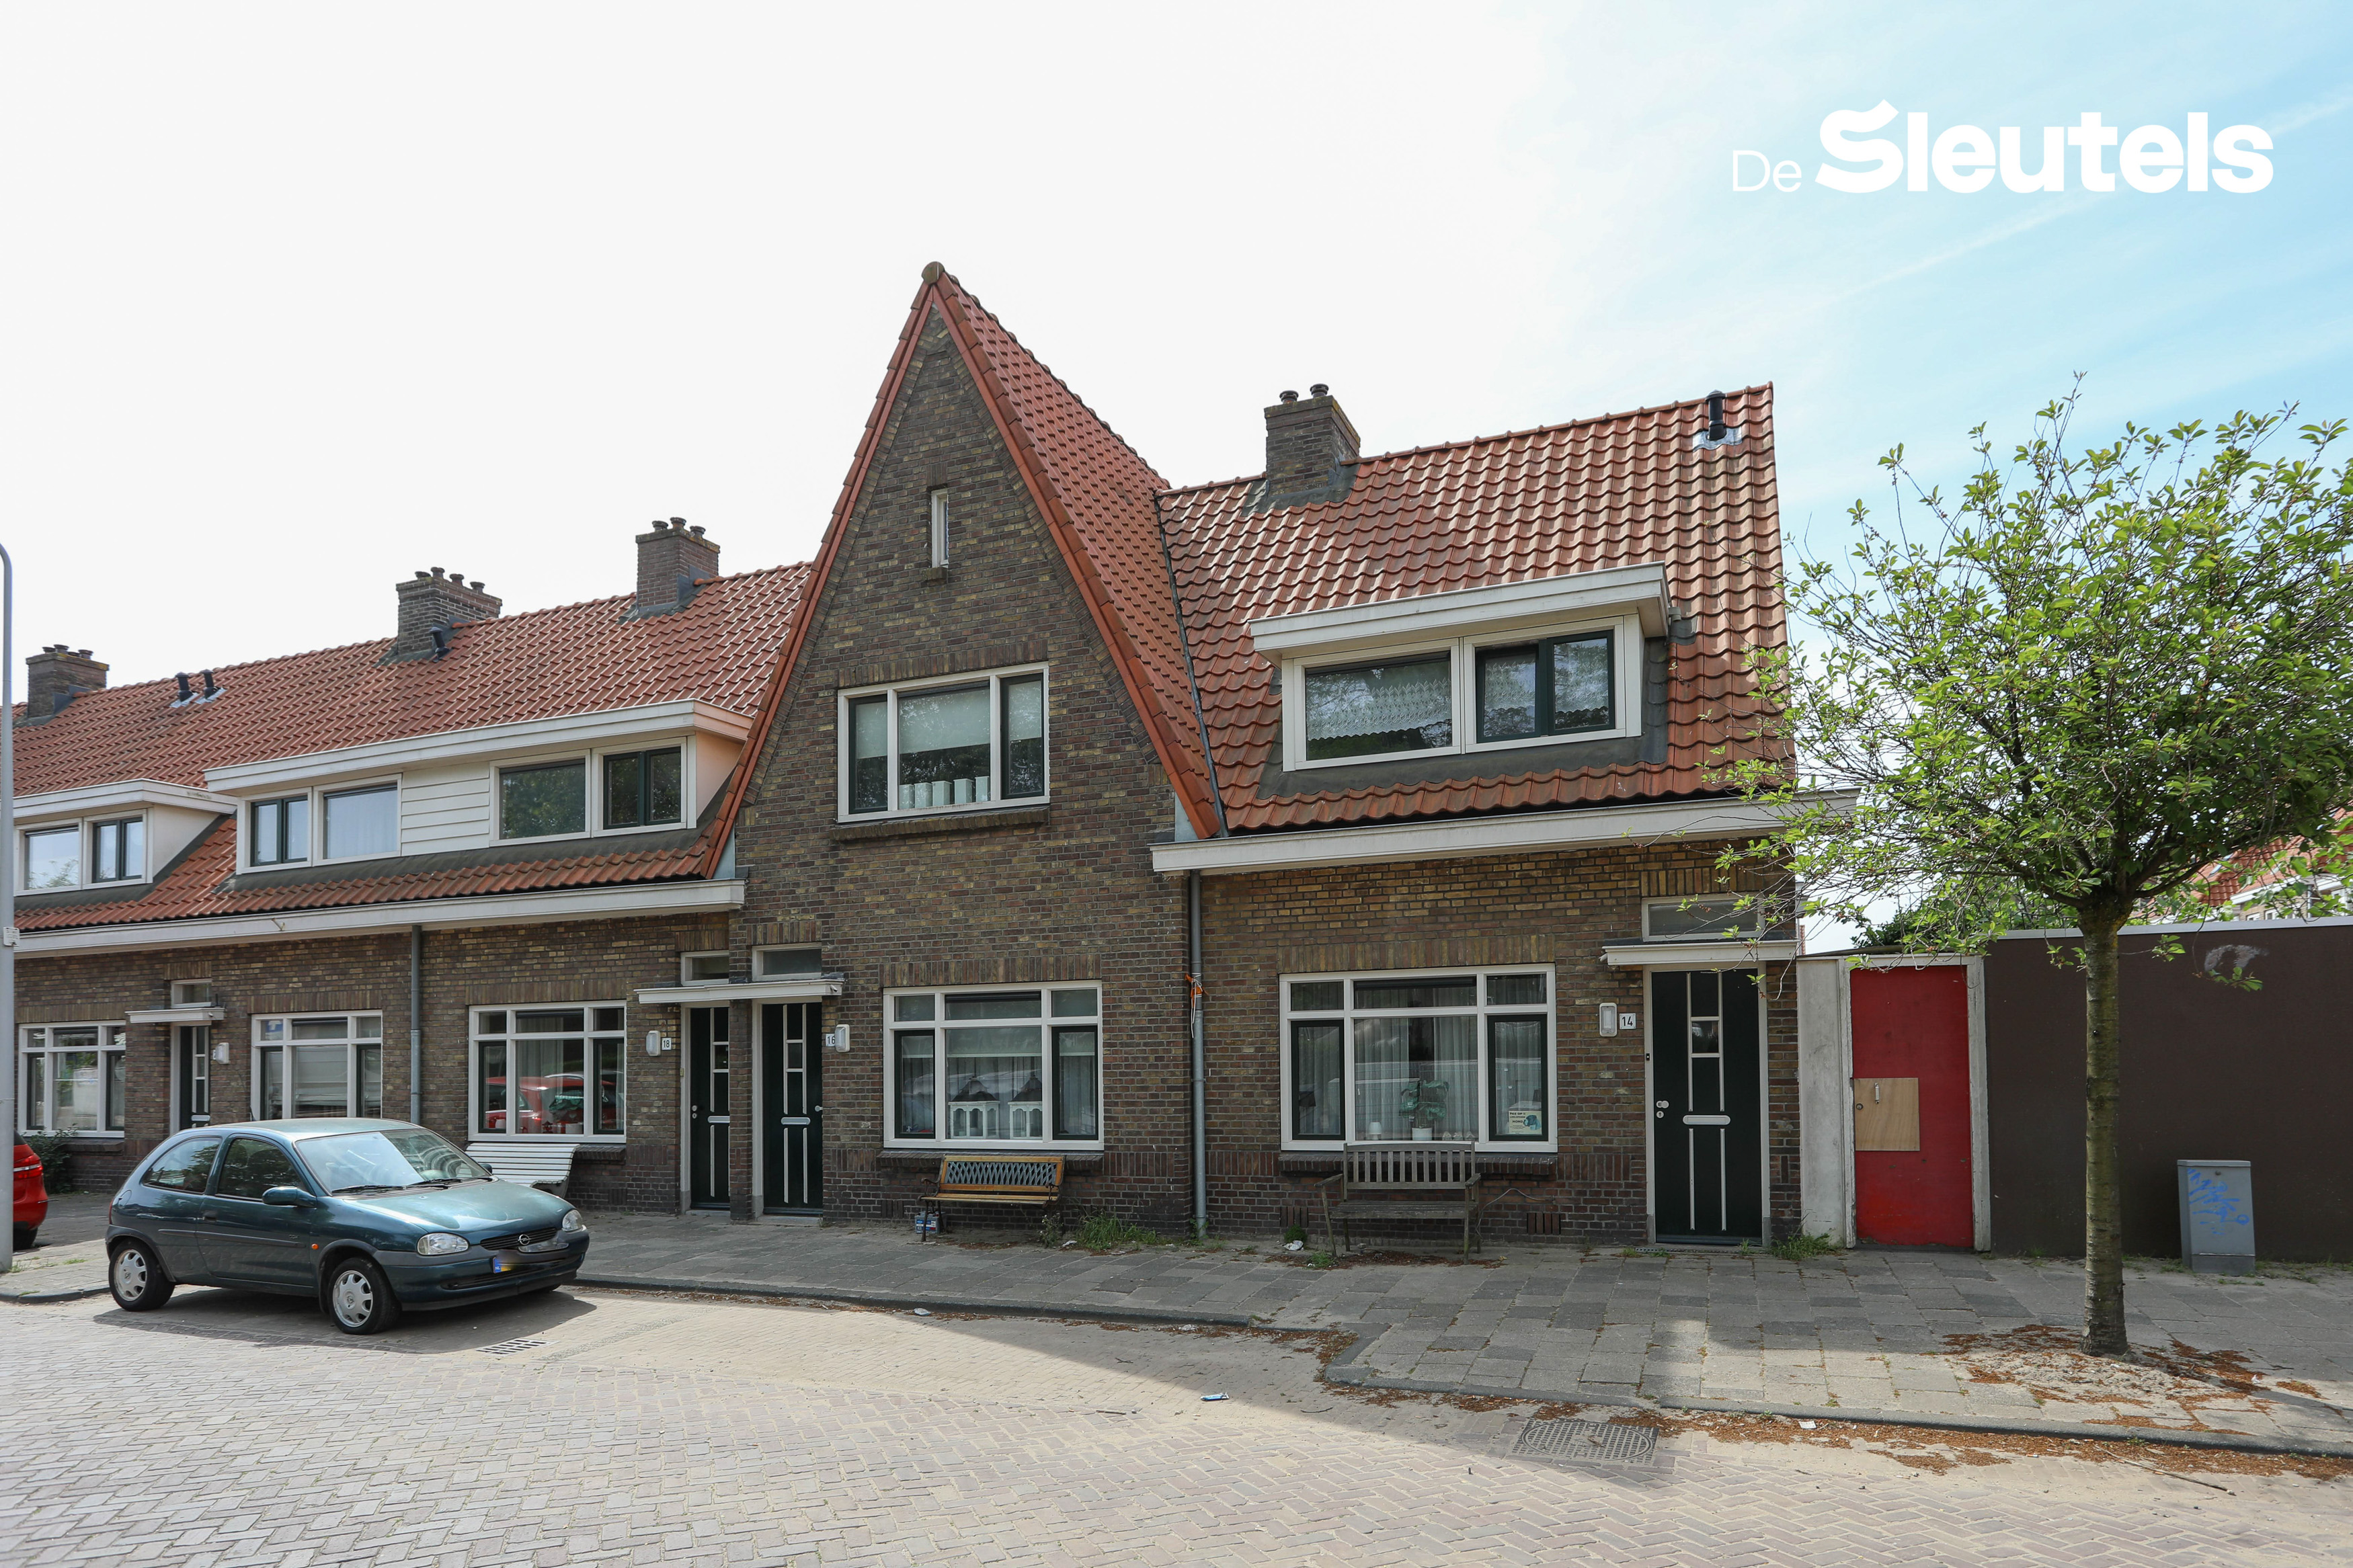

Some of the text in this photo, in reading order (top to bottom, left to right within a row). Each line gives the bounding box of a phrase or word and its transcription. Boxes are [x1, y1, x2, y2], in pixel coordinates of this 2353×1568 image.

[1622, 1016, 1634, 1026] 14
[663, 1040, 670, 1048] 18
[827, 1036, 836, 1044] 16
